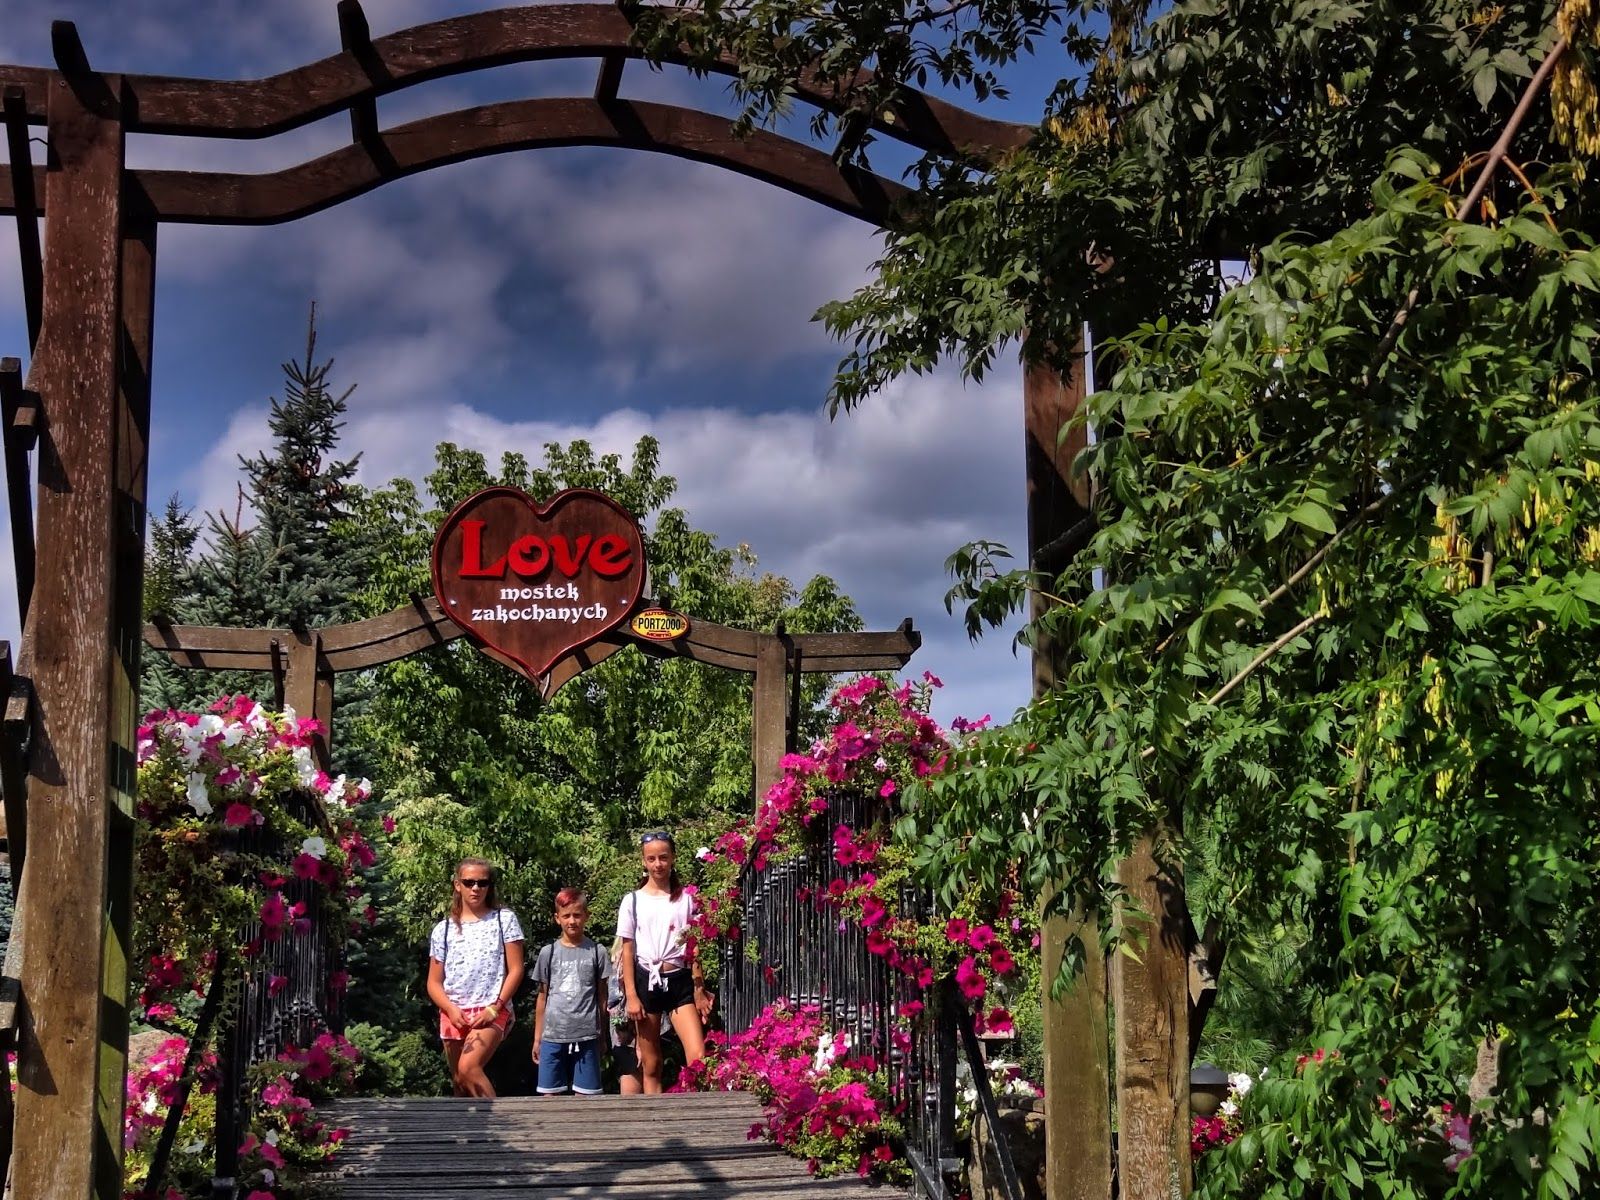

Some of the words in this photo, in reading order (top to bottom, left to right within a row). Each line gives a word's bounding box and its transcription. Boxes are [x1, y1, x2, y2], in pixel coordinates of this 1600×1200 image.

[458, 520, 633, 577] Love
[500, 583, 579, 602] mostek
[471, 603, 608, 624] zakochanych
[638, 617, 681, 631] PORT2000
